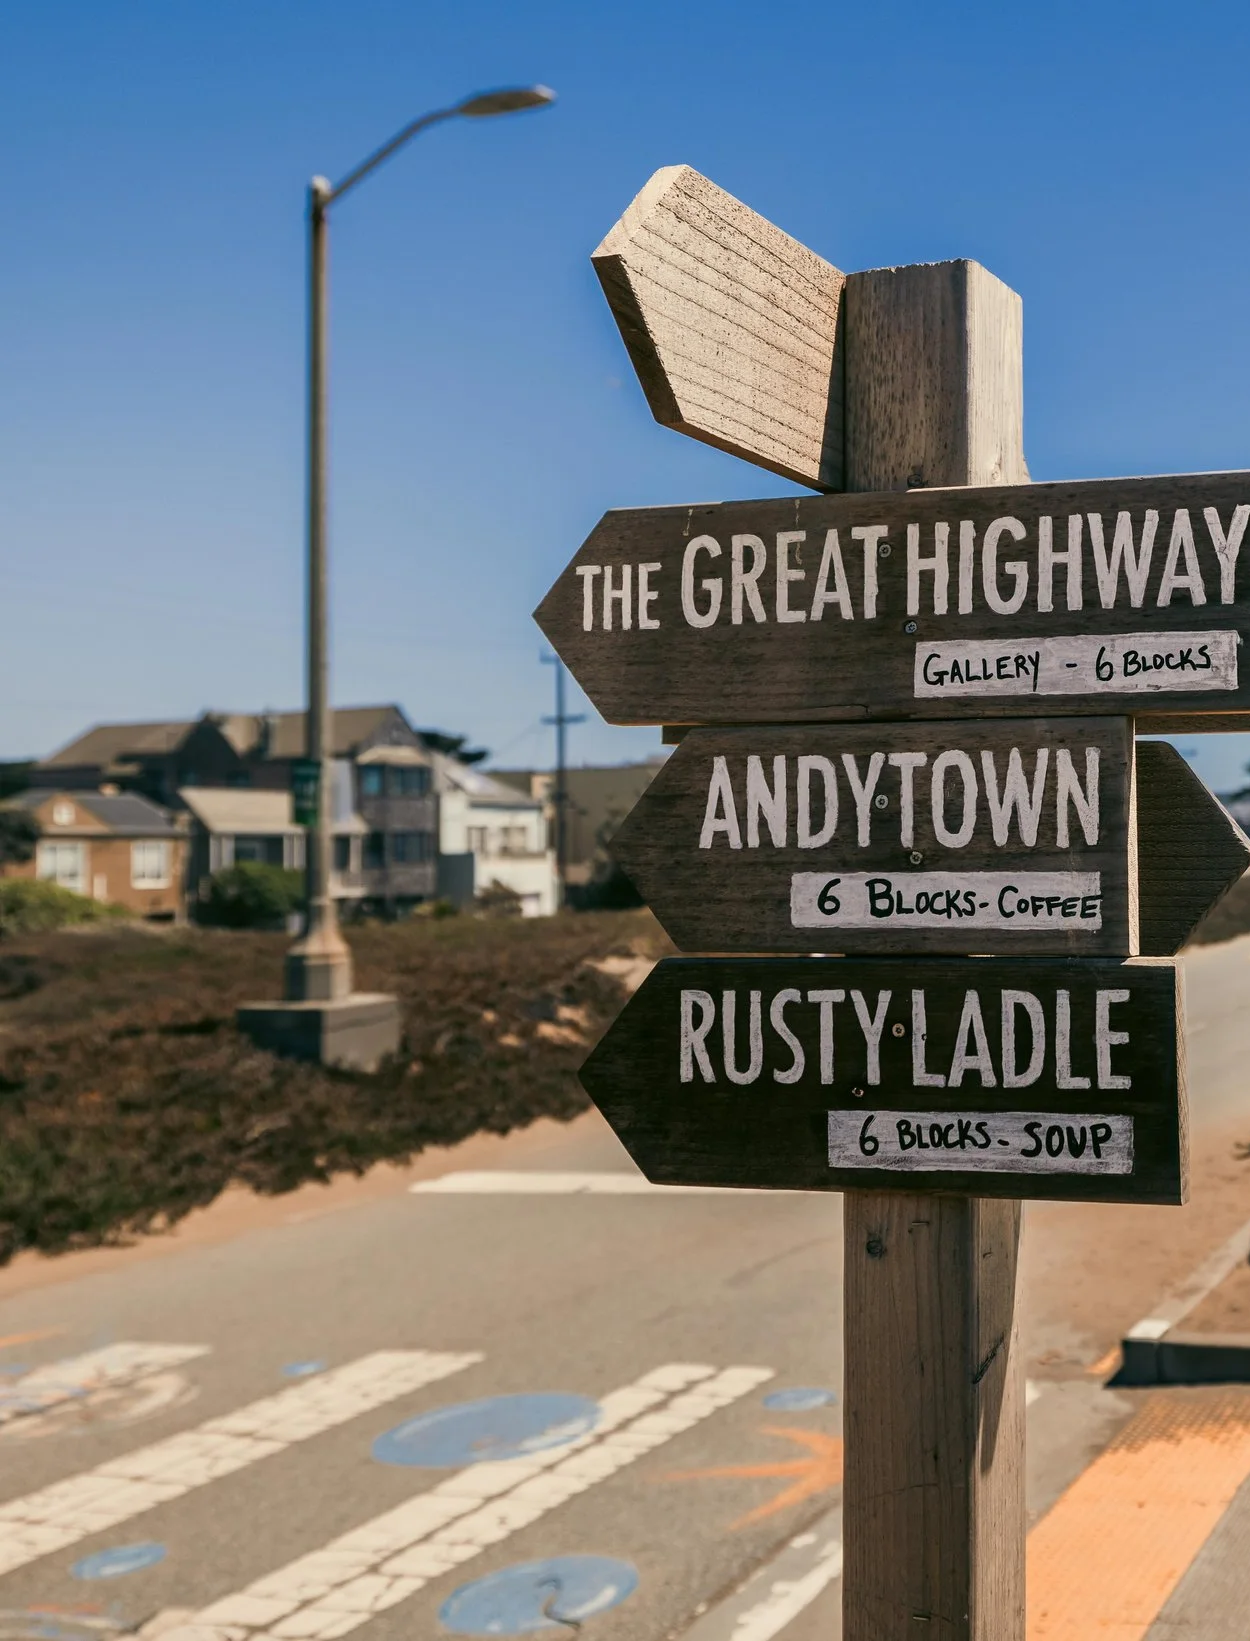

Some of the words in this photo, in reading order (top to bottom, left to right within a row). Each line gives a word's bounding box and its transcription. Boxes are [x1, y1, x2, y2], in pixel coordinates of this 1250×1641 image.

[575, 562, 662, 631] THE
[681, 525, 888, 628] GREAT
[923, 651, 1040, 692] GALLERY
[1096, 647, 1113, 681] 6
[1123, 645, 1212, 677] BLOCKS
[699, 746, 1100, 849] ANDYTOWN
[817, 878, 841, 915] 6
[998, 885, 1102, 919] COFFEE
[679, 988, 892, 1086] RUSTY
[911, 988, 1132, 1090] LADLE
[859, 1115, 879, 1156] 6
[1020, 1122, 1112, 1158] SOUP
